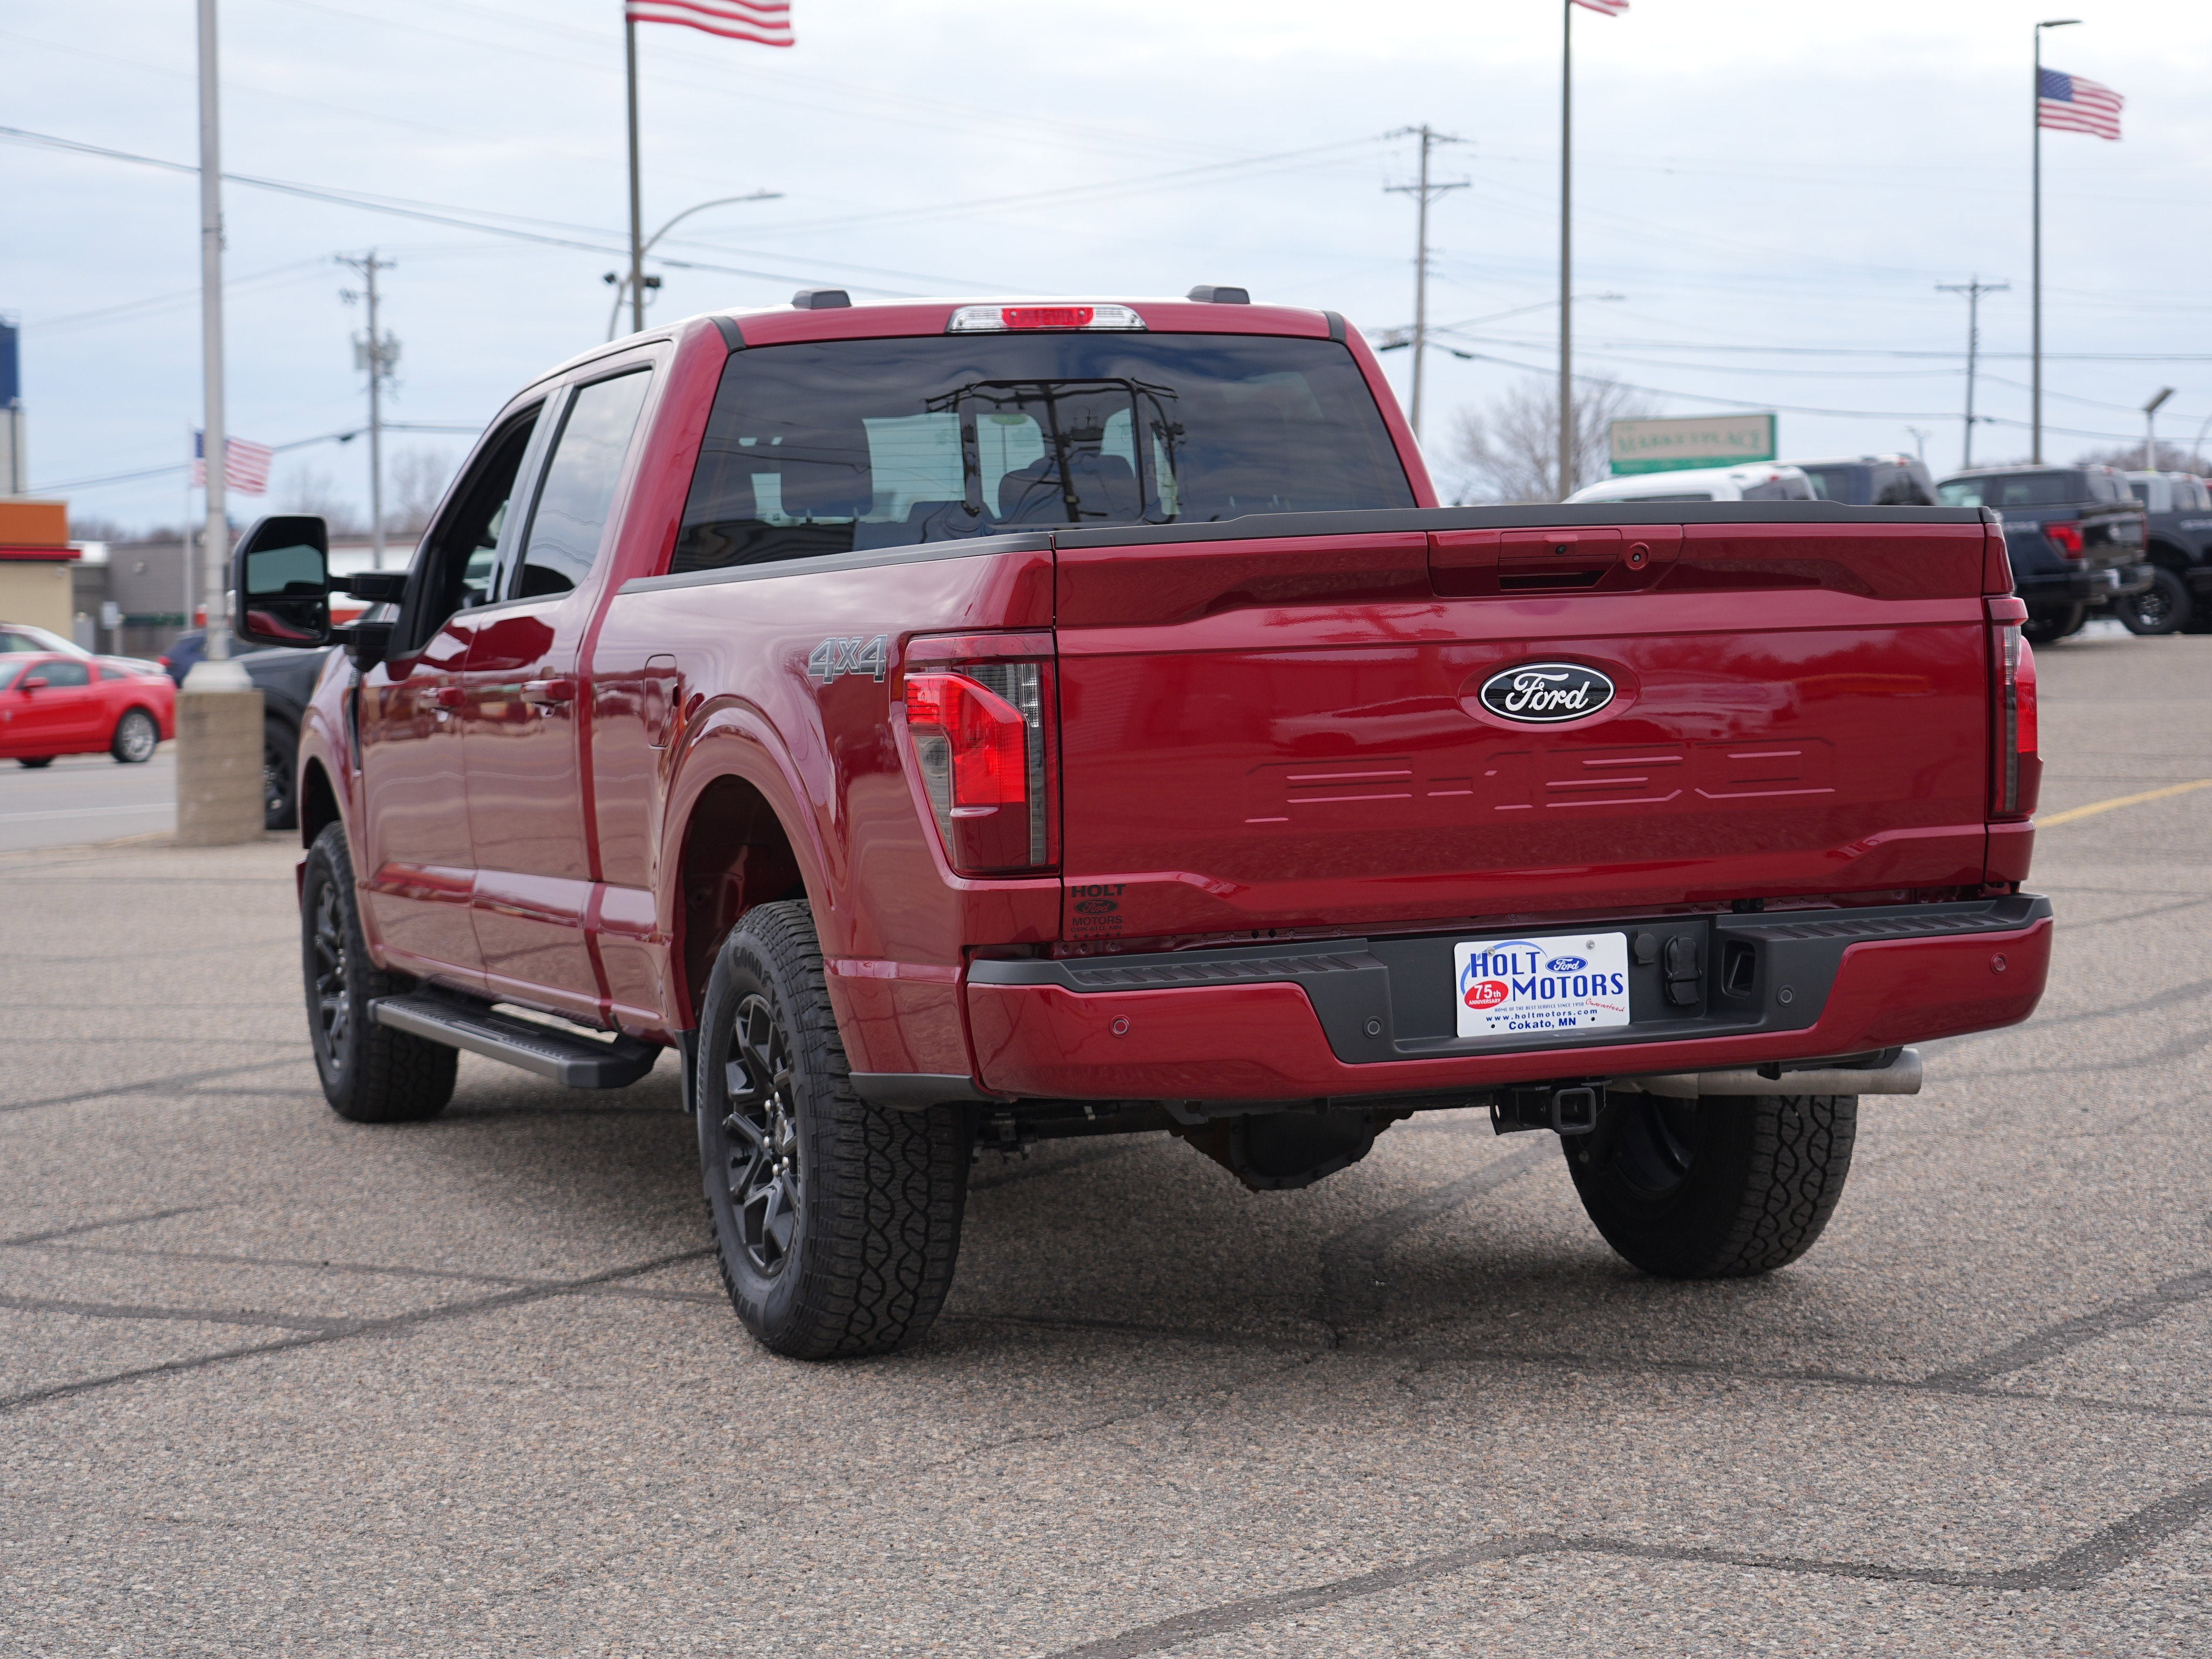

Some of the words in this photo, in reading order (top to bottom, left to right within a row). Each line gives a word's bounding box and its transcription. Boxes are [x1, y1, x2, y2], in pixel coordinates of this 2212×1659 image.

[1505, 673, 1590, 711] Ford
[1071, 884, 1127, 898] HOLT
[1082, 900, 1110, 912] Ford
[1073, 915, 1123, 925] MOTORS
[1470, 952, 1540, 978] HOLT
[1553, 958, 1580, 971] Ford
[1474, 983, 1501, 999] 75th
[1512, 973, 1623, 1001] MOTORS
[1468, 997, 1501, 1006] ANNIVERSARY
[1586, 998, 1625, 1012] Guaranteed
[1486, 1009, 1597, 1021] www.holtmotors.com
[1509, 1020, 1554, 1030] Cokato,
[1559, 1017, 1576, 1026] MN
